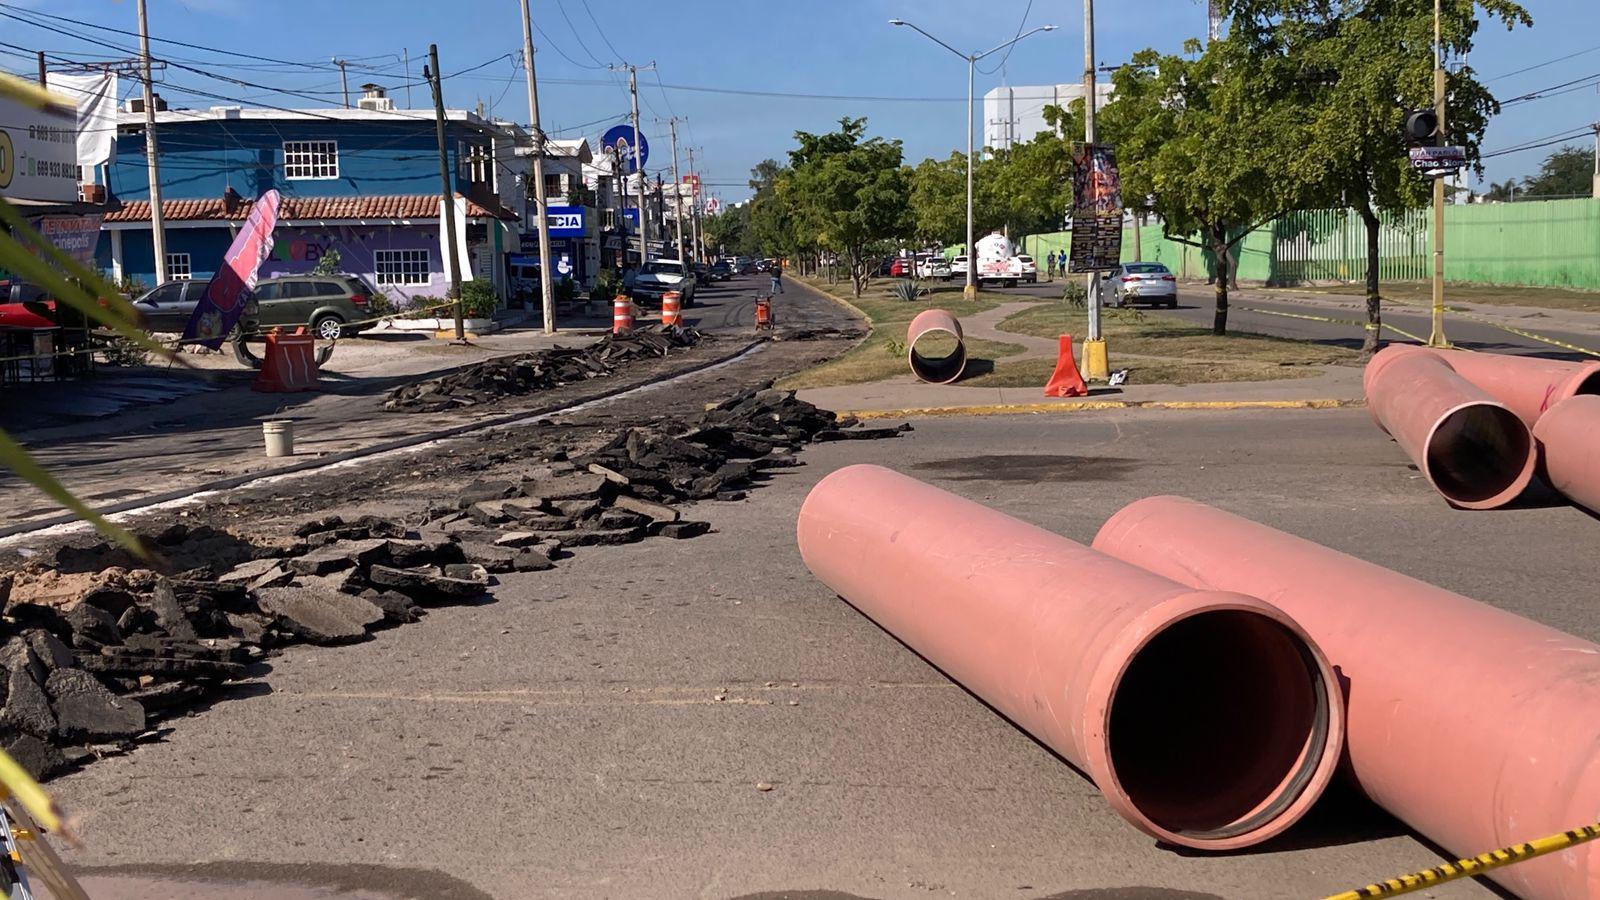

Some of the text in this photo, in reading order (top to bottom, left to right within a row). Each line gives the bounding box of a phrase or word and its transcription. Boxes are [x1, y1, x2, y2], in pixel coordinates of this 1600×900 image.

[37, 160, 49, 176] 669
[49, 161, 61, 178] 933
[556, 216, 579, 227] CIA
